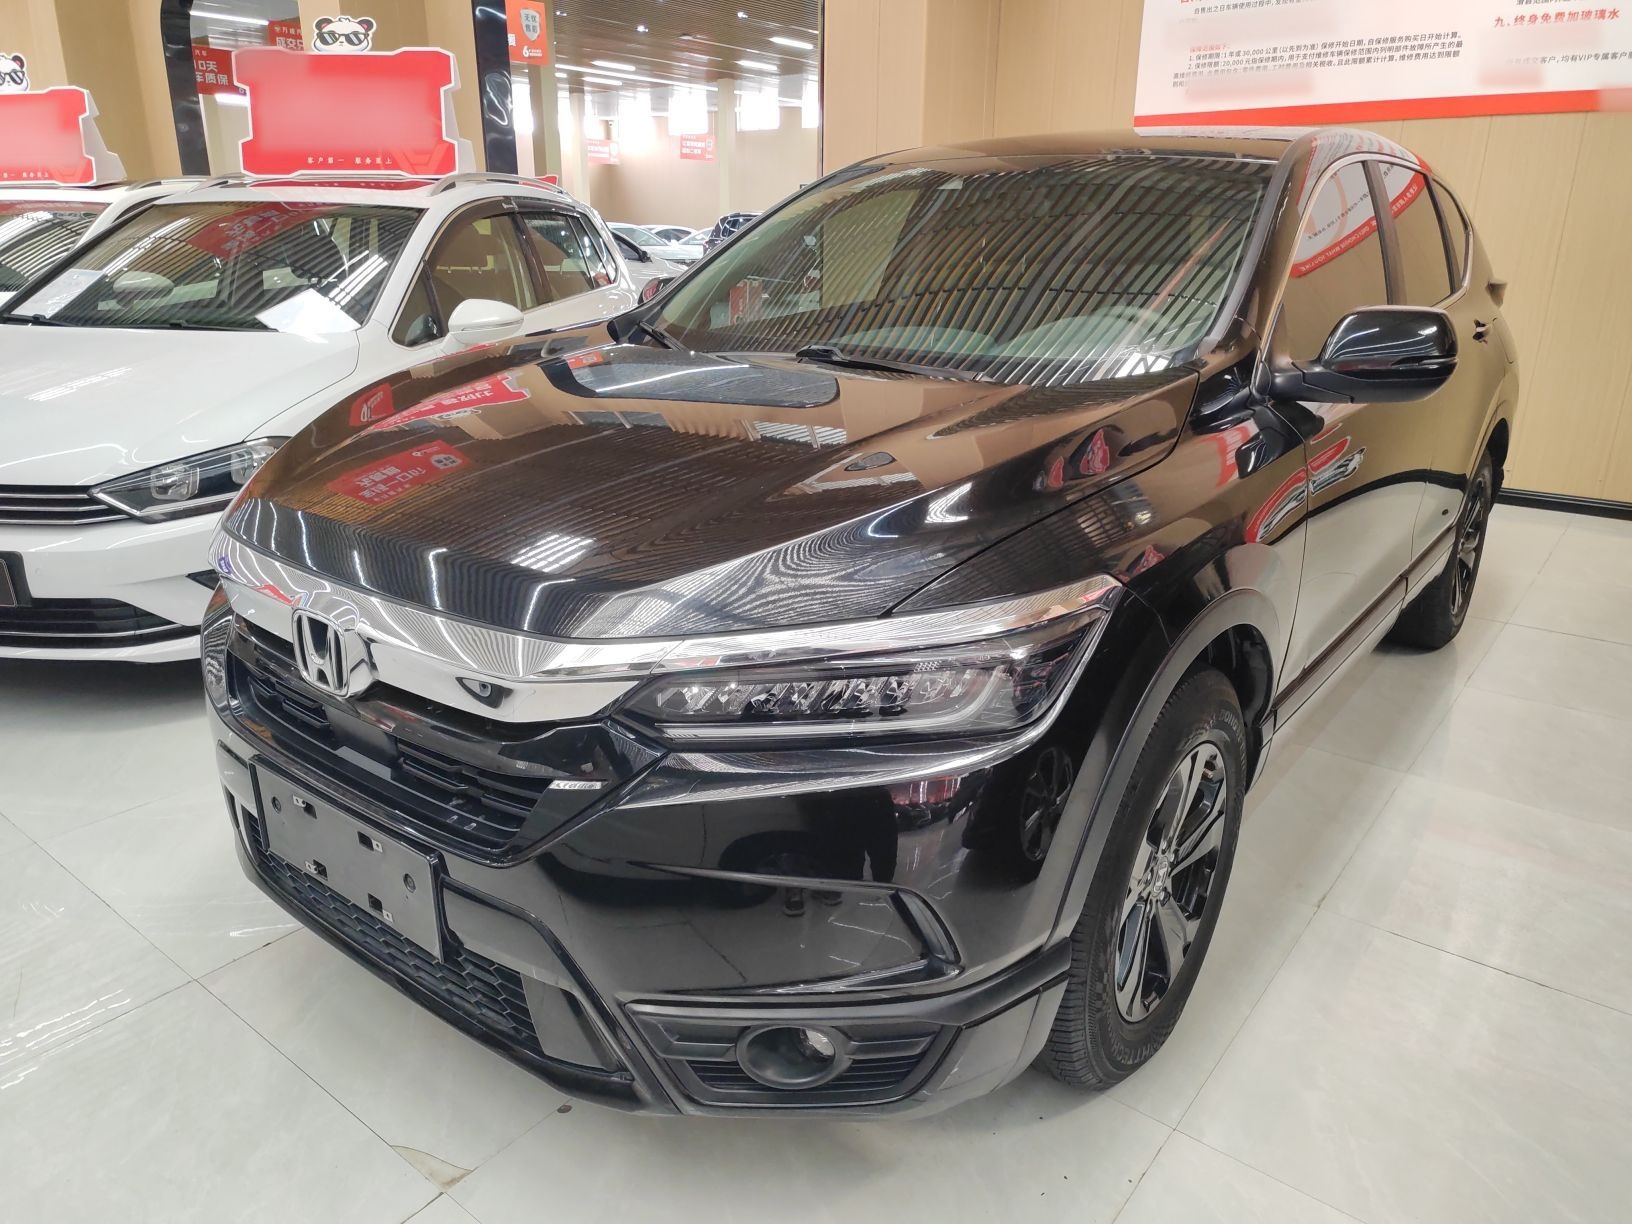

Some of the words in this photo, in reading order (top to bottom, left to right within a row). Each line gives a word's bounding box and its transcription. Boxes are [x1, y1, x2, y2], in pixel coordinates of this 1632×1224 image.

[1494, 8, 1620, 28] 九、终身免费加玻璃水
